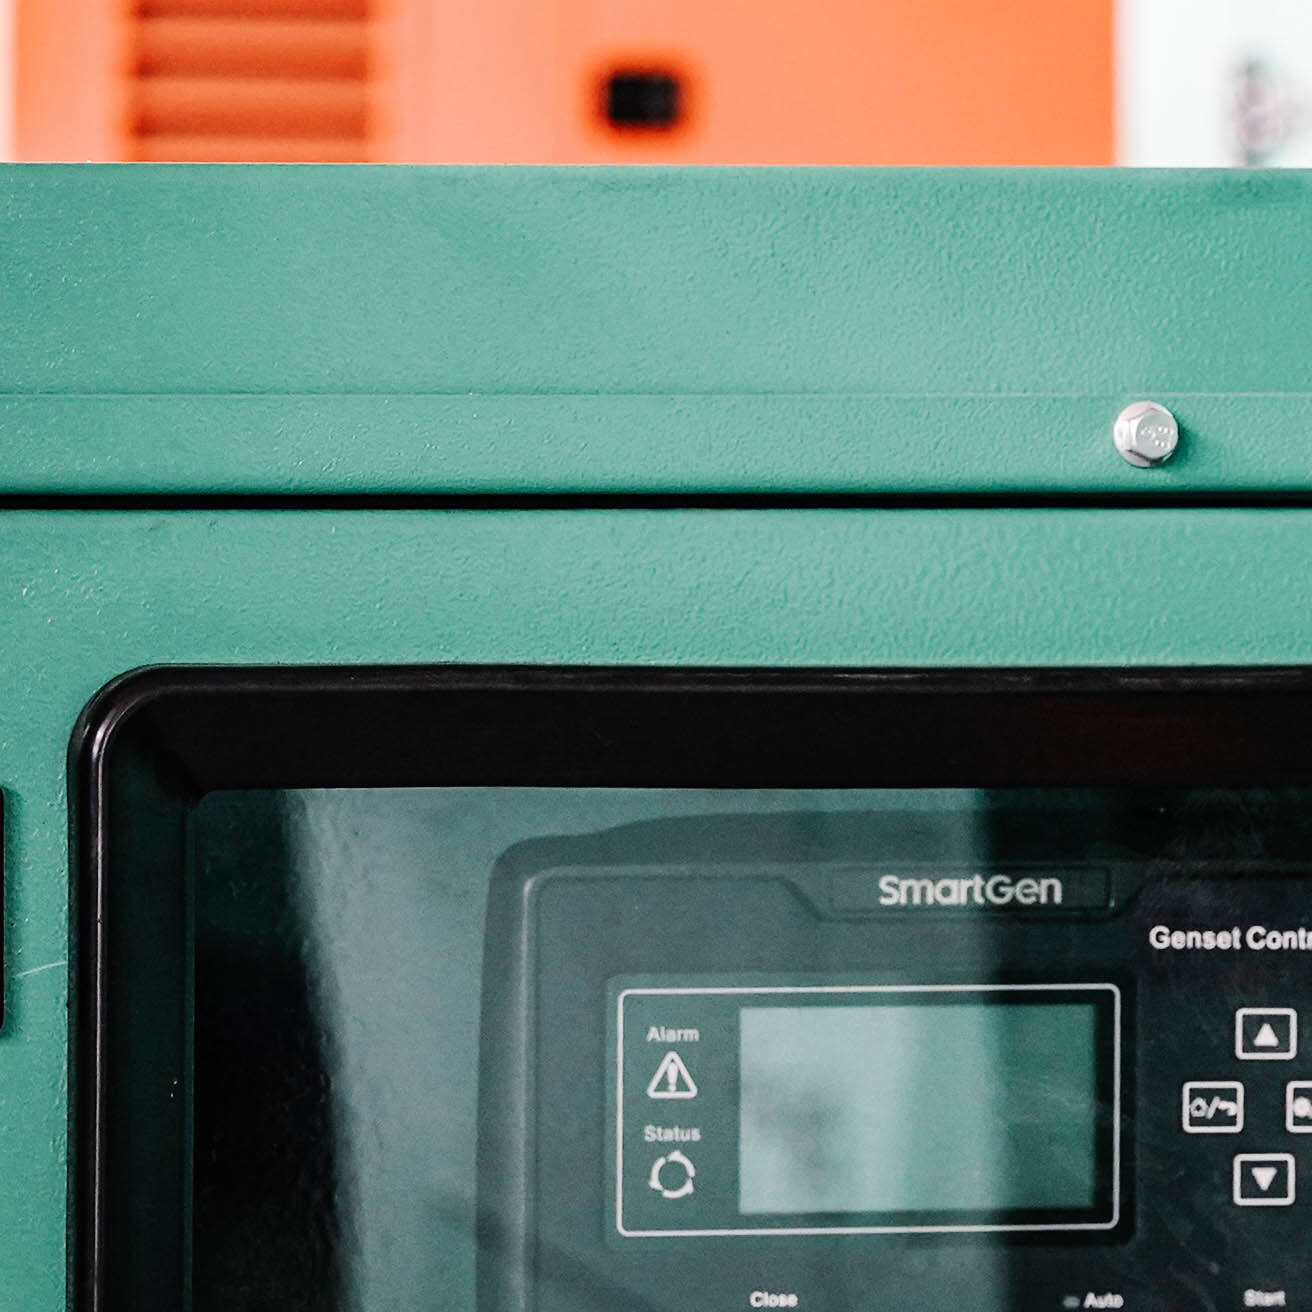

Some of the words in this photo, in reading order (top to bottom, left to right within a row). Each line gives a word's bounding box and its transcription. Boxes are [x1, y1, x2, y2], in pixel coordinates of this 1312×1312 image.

[878, 874, 1063, 905] SmartGen
[1149, 925, 1242, 950] Genset
[646, 1026, 700, 1042] Alarm
[644, 1124, 701, 1142] Status
[750, 1291, 798, 1307] Close
[1083, 1292, 1124, 1309] Auto
[1244, 1289, 1286, 1307] Start
